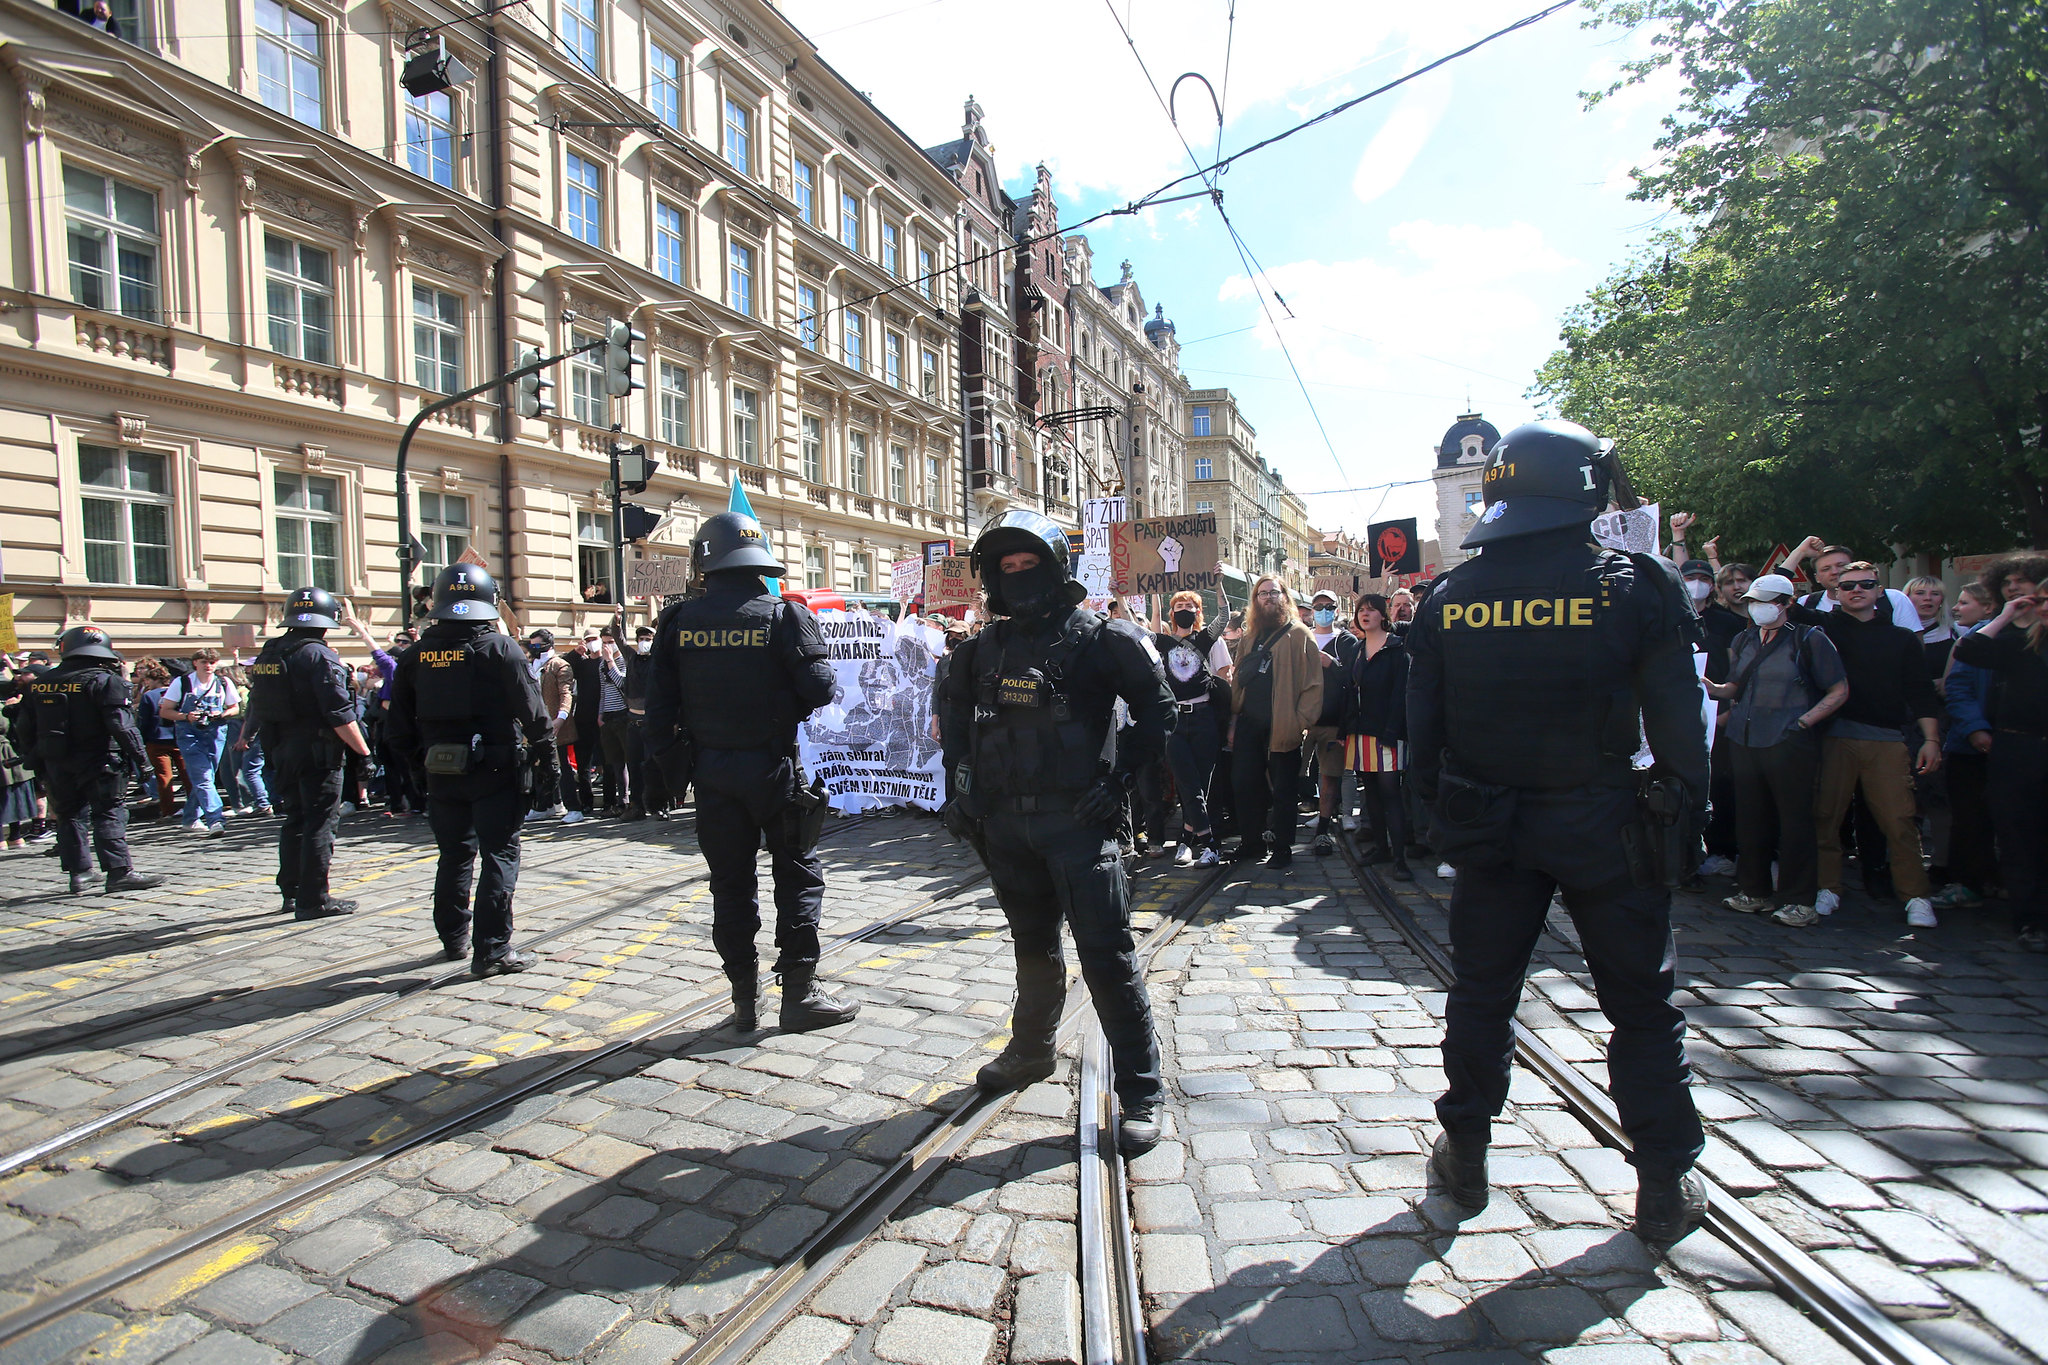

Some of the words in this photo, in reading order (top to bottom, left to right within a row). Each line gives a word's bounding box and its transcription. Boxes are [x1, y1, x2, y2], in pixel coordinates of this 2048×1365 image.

[1484, 463, 1515, 484] A971
[1134, 514, 1216, 542] PATRIARCHÁTU
[1085, 526, 1109, 549] ŠPAT
[943, 559, 965, 569] MOJE
[1112, 522, 1130, 595] KONEC
[635, 559, 681, 577] KONEC
[942, 578, 964, 587] MOJE
[1443, 598, 1593, 629] POLICIE
[679, 629, 765, 647] POLICIE
[420, 650, 465, 662] POLICIE
[253, 664, 280, 675] POLICIE
[31, 683, 82, 693] POLICIE
[1001, 678, 1037, 690] POLICIE
[1003, 691, 1033, 703] 313207
[846, 749, 885, 762] sebrat
[854, 768, 869, 777] se
[828, 778, 860, 796] SVÉM
[913, 784, 937, 801] TĚLE
